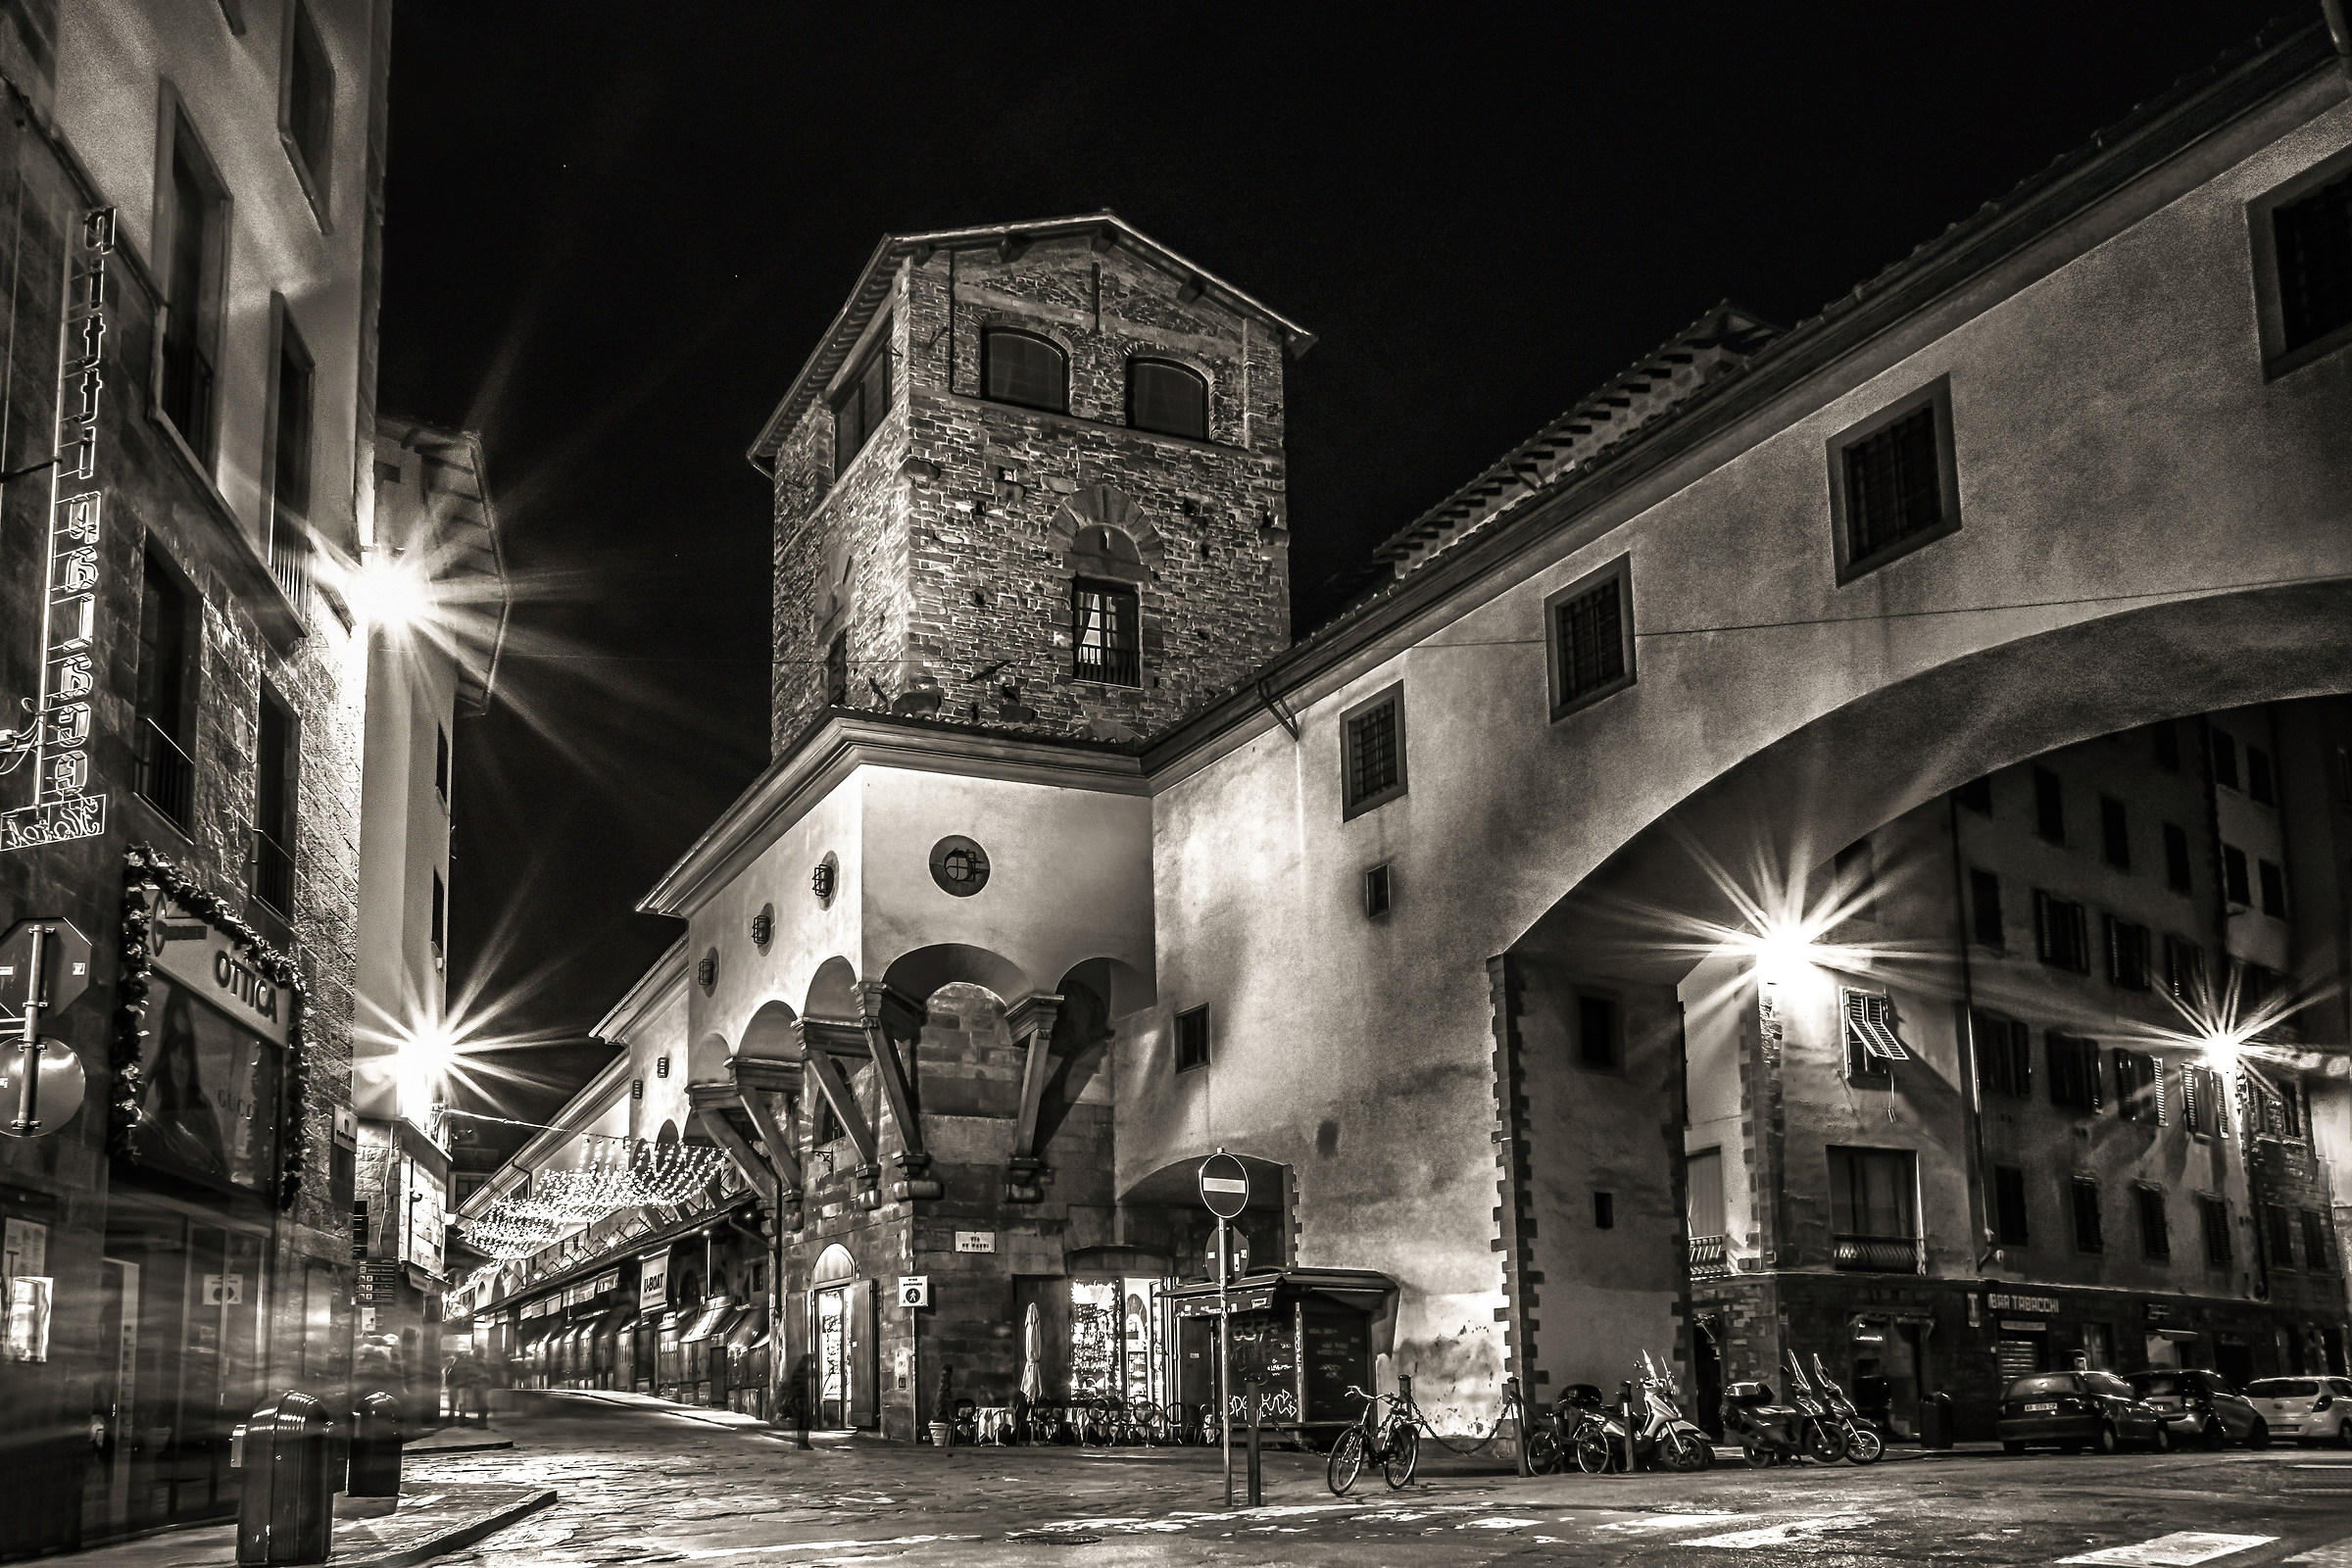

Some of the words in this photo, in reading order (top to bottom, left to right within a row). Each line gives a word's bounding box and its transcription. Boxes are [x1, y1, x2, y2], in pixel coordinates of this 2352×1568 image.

[215, 949, 277, 1024] OTTICA
[644, 1272, 664, 1294] U-BOAT
[1987, 1293, 2010, 1309] BAR
[2011, 1295, 2060, 1313] TABACCHI
